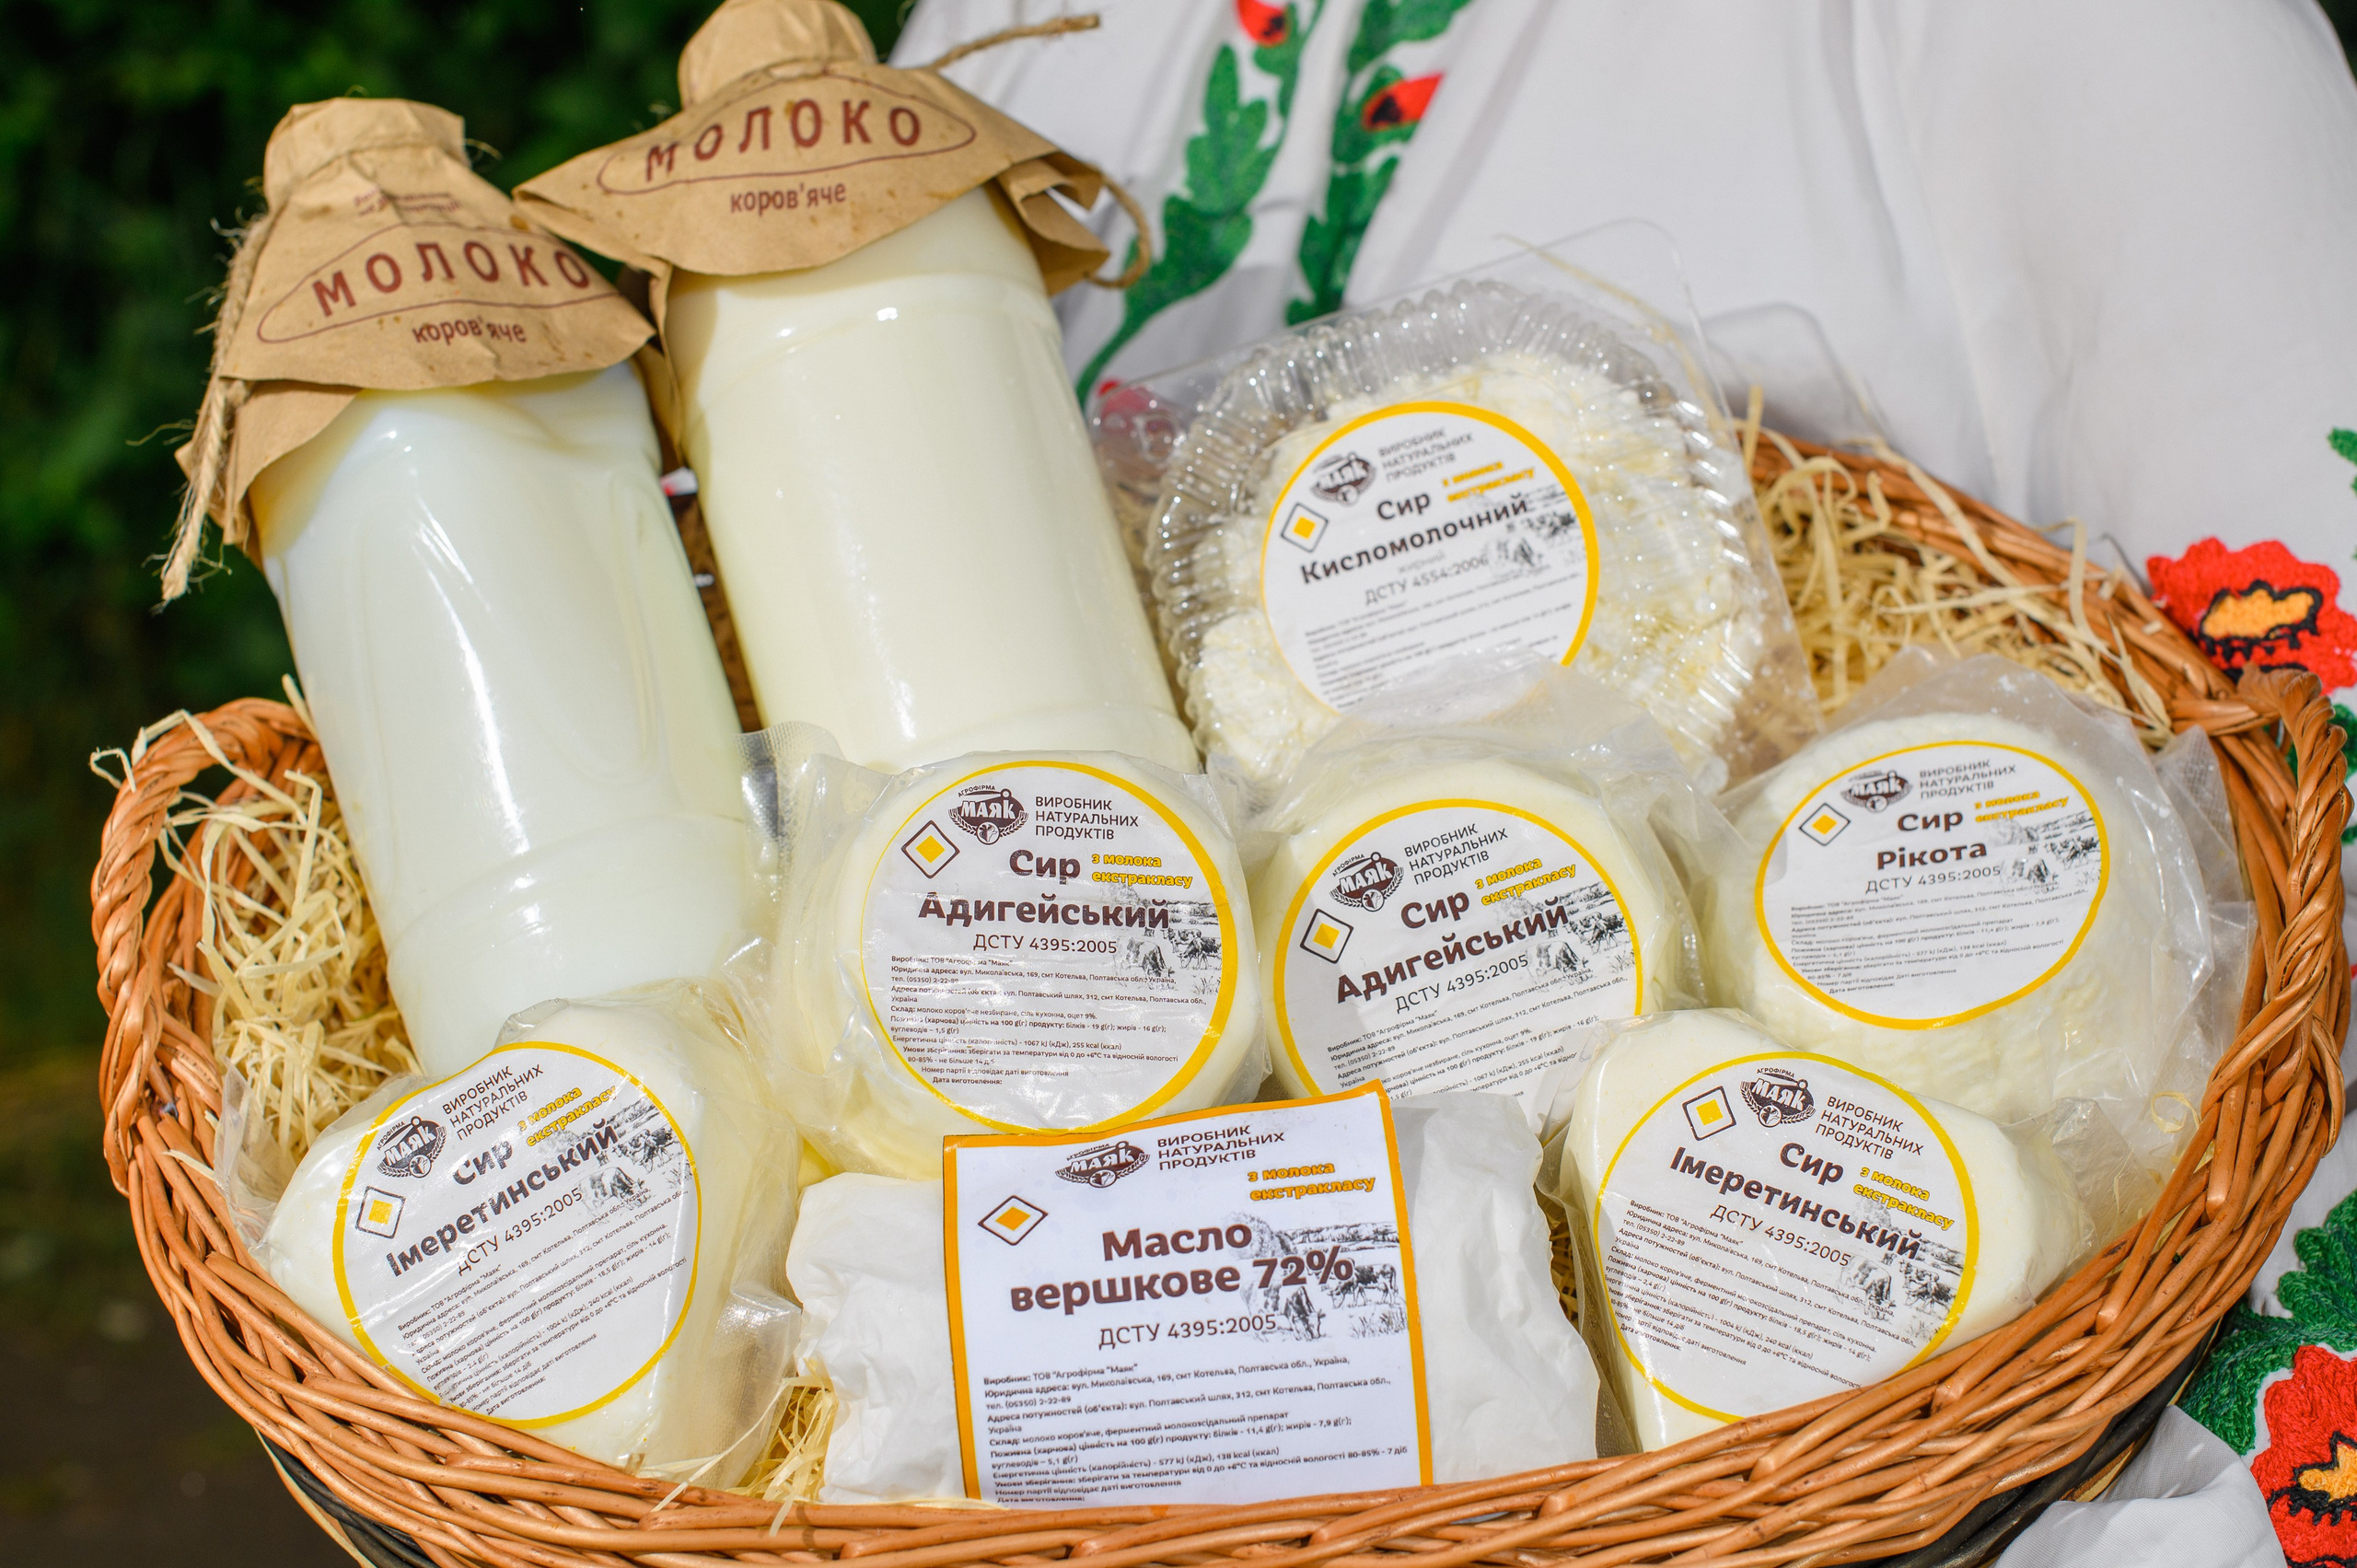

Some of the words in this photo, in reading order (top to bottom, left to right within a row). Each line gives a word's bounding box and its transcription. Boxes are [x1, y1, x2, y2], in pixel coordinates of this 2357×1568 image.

[646, 99, 922, 181] МОЛОКО
[731, 183, 846, 216] коров'яче
[311, 241, 590, 317] МОЛОКО
[412, 317, 526, 345] коров'яче
[1376, 494, 1431, 520] Сир
[1301, 492, 1528, 584] Кисломолочний
[1364, 578, 1407, 607] ДСТУ
[1920, 760, 1990, 778] ВИРОБНИК
[1920, 765, 2015, 789] НАТУРАЛЬНИХ
[958, 784, 996, 797] АГРОФІРМА
[1036, 796, 1112, 811] ВИРОБНИК
[1851, 778, 1902, 796] МАЯК
[1921, 780, 1994, 799] ПРОДУКТІВ
[961, 796, 1016, 819] МАЯК
[1036, 810, 1139, 827] НАТУРАЛЬНИХ
[1898, 811, 1963, 832] Сир
[1036, 825, 1114, 841] ПРОДУКТІВ
[1404, 823, 1478, 857] ВИРОБНИК
[1409, 828, 1508, 871] НАТУРАЛЬНИХ
[1009, 849, 1081, 886] Сир
[1091, 854, 1100, 864] з
[1103, 854, 1162, 867] молока
[1332, 854, 1364, 877] АГРОФІРМА
[1413, 851, 1490, 885] ПРОДУКТІВ
[1877, 842, 1987, 870] Рікота
[1092, 871, 1193, 889] екстракласу
[1340, 862, 1393, 894] МАЯК
[1475, 878, 1484, 889] з
[1485, 858, 1542, 886] молока
[1481, 864, 1575, 906] екстракласу
[1865, 876, 1912, 895] ДСТУ
[1918, 865, 2003, 886] 4395:2005
[917, 891, 1170, 929] Адигейський
[1400, 892, 1469, 929] Сир
[973, 934, 1024, 952] ДСТУ
[1028, 936, 1118, 954] 4395:2005
[1337, 896, 1568, 1005] Адигейський
[1395, 982, 1440, 1015] ДСТУ
[1447, 954, 1528, 992] 4395:2005
[1330, 1046, 1366, 1062] Юридична
[1366, 1037, 1392, 1050] адреса:
[1406, 1016, 1453, 1036] Миколаївська,
[1467, 1006, 1479, 1015] смт
[1480, 996, 1512, 1009] Котельва,
[1511, 981, 1550, 999] Полтавська
[1327, 1037, 1363, 1052] Виробник:
[1362, 1031, 1376, 1040] ТОВ
[1371, 1045, 1396, 1058] 2-22-89
[1757, 1067, 1794, 1079] АГРОФІРМА
[442, 1065, 513, 1115] ВИРОБНИК
[449, 1064, 543, 1128] НАТУРАЛЬНИХ
[1751, 1077, 1805, 1110] МАЯК
[457, 1091, 528, 1141] ПРОДУКТІВ
[517, 1120, 527, 1132] з
[528, 1087, 583, 1122] молока
[527, 1086, 615, 1146] екстракласу
[1827, 1096, 1904, 1132] ВИРОБНИК
[376, 1121, 406, 1151] АГРОФІРМА
[384, 1125, 437, 1166] МАЯК
[1157, 1125, 1251, 1148] ВИРОБНИК
[1158, 1132, 1284, 1159] НАТУРАЛЬНИХ
[1815, 1123, 1894, 1160] ПРОДУКТІВ
[1820, 1109, 1924, 1156] НАТУРАЛЬНИХ
[452, 1141, 513, 1185] Сир
[1066, 1143, 1110, 1161] АГРОФІРМА
[1070, 1147, 1135, 1173] МАЯК
[1159, 1149, 1256, 1170] ПРОДУКТІВ
[1780, 1143, 1844, 1185] Сир
[1248, 1171, 1258, 1182] з
[1262, 1163, 1335, 1180] молока
[1250, 1177, 1376, 1201] екстракласу
[1860, 1167, 1870, 1177] з
[1871, 1171, 1930, 1201] молока
[385, 1118, 620, 1277] Імеретинський
[505, 1183, 585, 1242] 4395:2005
[1630, 1200, 1665, 1217] Виробник:
[1666, 1213, 1680, 1223] ТОВ
[1669, 1146, 1922, 1260] Імеретинський
[1853, 1183, 1954, 1230] екстракласу
[1102, 1223, 1253, 1261] Масло
[1614, 1236, 1640, 1250] Україна
[1622, 1219, 1635, 1228] тел.
[1636, 1224, 1661, 1237] (05350)
[1660, 1233, 1686, 1247] 2-22-89
[1709, 1204, 1763, 1231] ДСТУ
[1764, 1225, 1852, 1267] 4395:2005
[1626, 1210, 1662, 1227] Юридична
[1662, 1224, 1689, 1237] адреса:
[1702, 1238, 1749, 1261] Миколаївська,
[1751, 1257, 1763, 1267] 169,
[1764, 1262, 1777, 1271] смт
[1777, 1266, 1809, 1284] Котельва,
[1810, 1279, 1850, 1300] Полтавська
[1010, 1266, 1241, 1316] вершкове
[1252, 1245, 1353, 1290] 72%
[398, 1308, 432, 1331] Виробник:
[430, 1300, 445, 1311] ТОВ
[1098, 1323, 1160, 1351] ДСТУ
[1167, 1314, 1277, 1339] 4395:2005
[983, 1376, 1031, 1386] Виробник:
[1032, 1372, 1051, 1381] ТОВ
[984, 1388, 1034, 1399] Юридична
[1035, 1384, 1070, 1395] адреса:
[1090, 1376, 1155, 1388] Миколаївська,
[1157, 1374, 1174, 1382] 169,
[1193, 1368, 1237, 1378] Котельва,
[1238, 1363, 1289, 1374] Полтавська
[989, 1438, 1020, 1446] Склад:
[1022, 1434, 1056, 1443] молоко
[1105, 1423, 1162, 1437] ферментний
[1248, 1411, 1289, 1423] препарат
